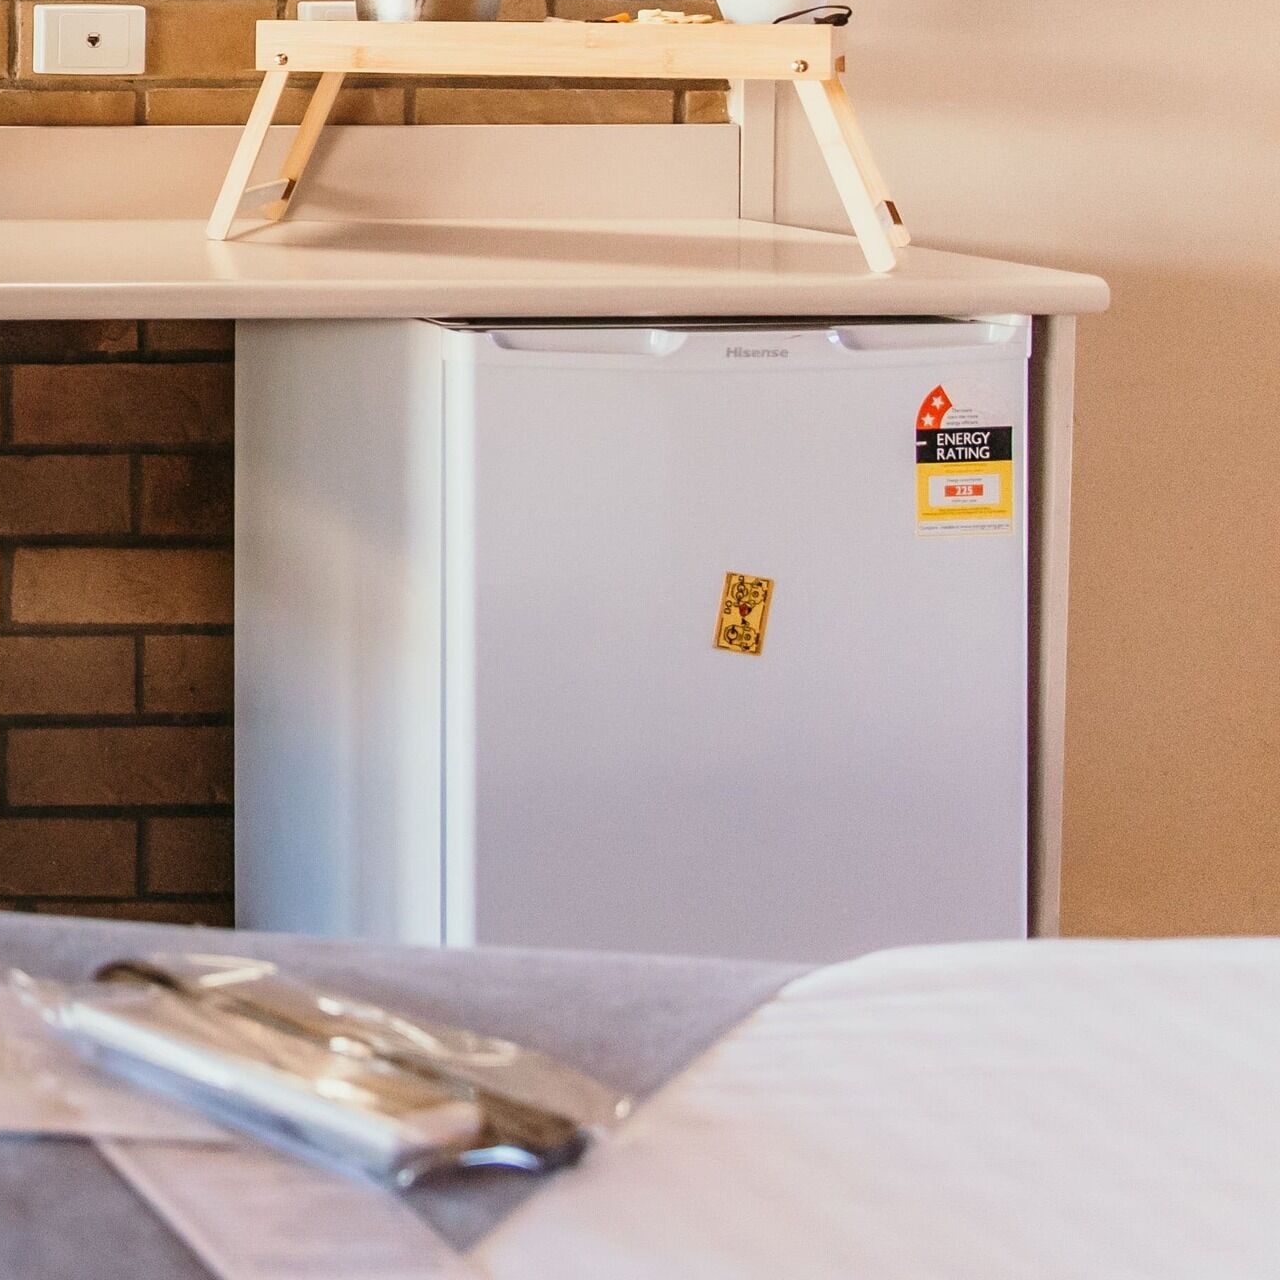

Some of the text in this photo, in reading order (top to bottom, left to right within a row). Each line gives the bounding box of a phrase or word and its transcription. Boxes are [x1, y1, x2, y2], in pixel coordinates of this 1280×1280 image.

[726, 347, 789, 358] Hisense
[936, 432, 990, 446] ENERGY
[936, 447, 990, 460] RATING
[955, 485, 973, 496] 225
